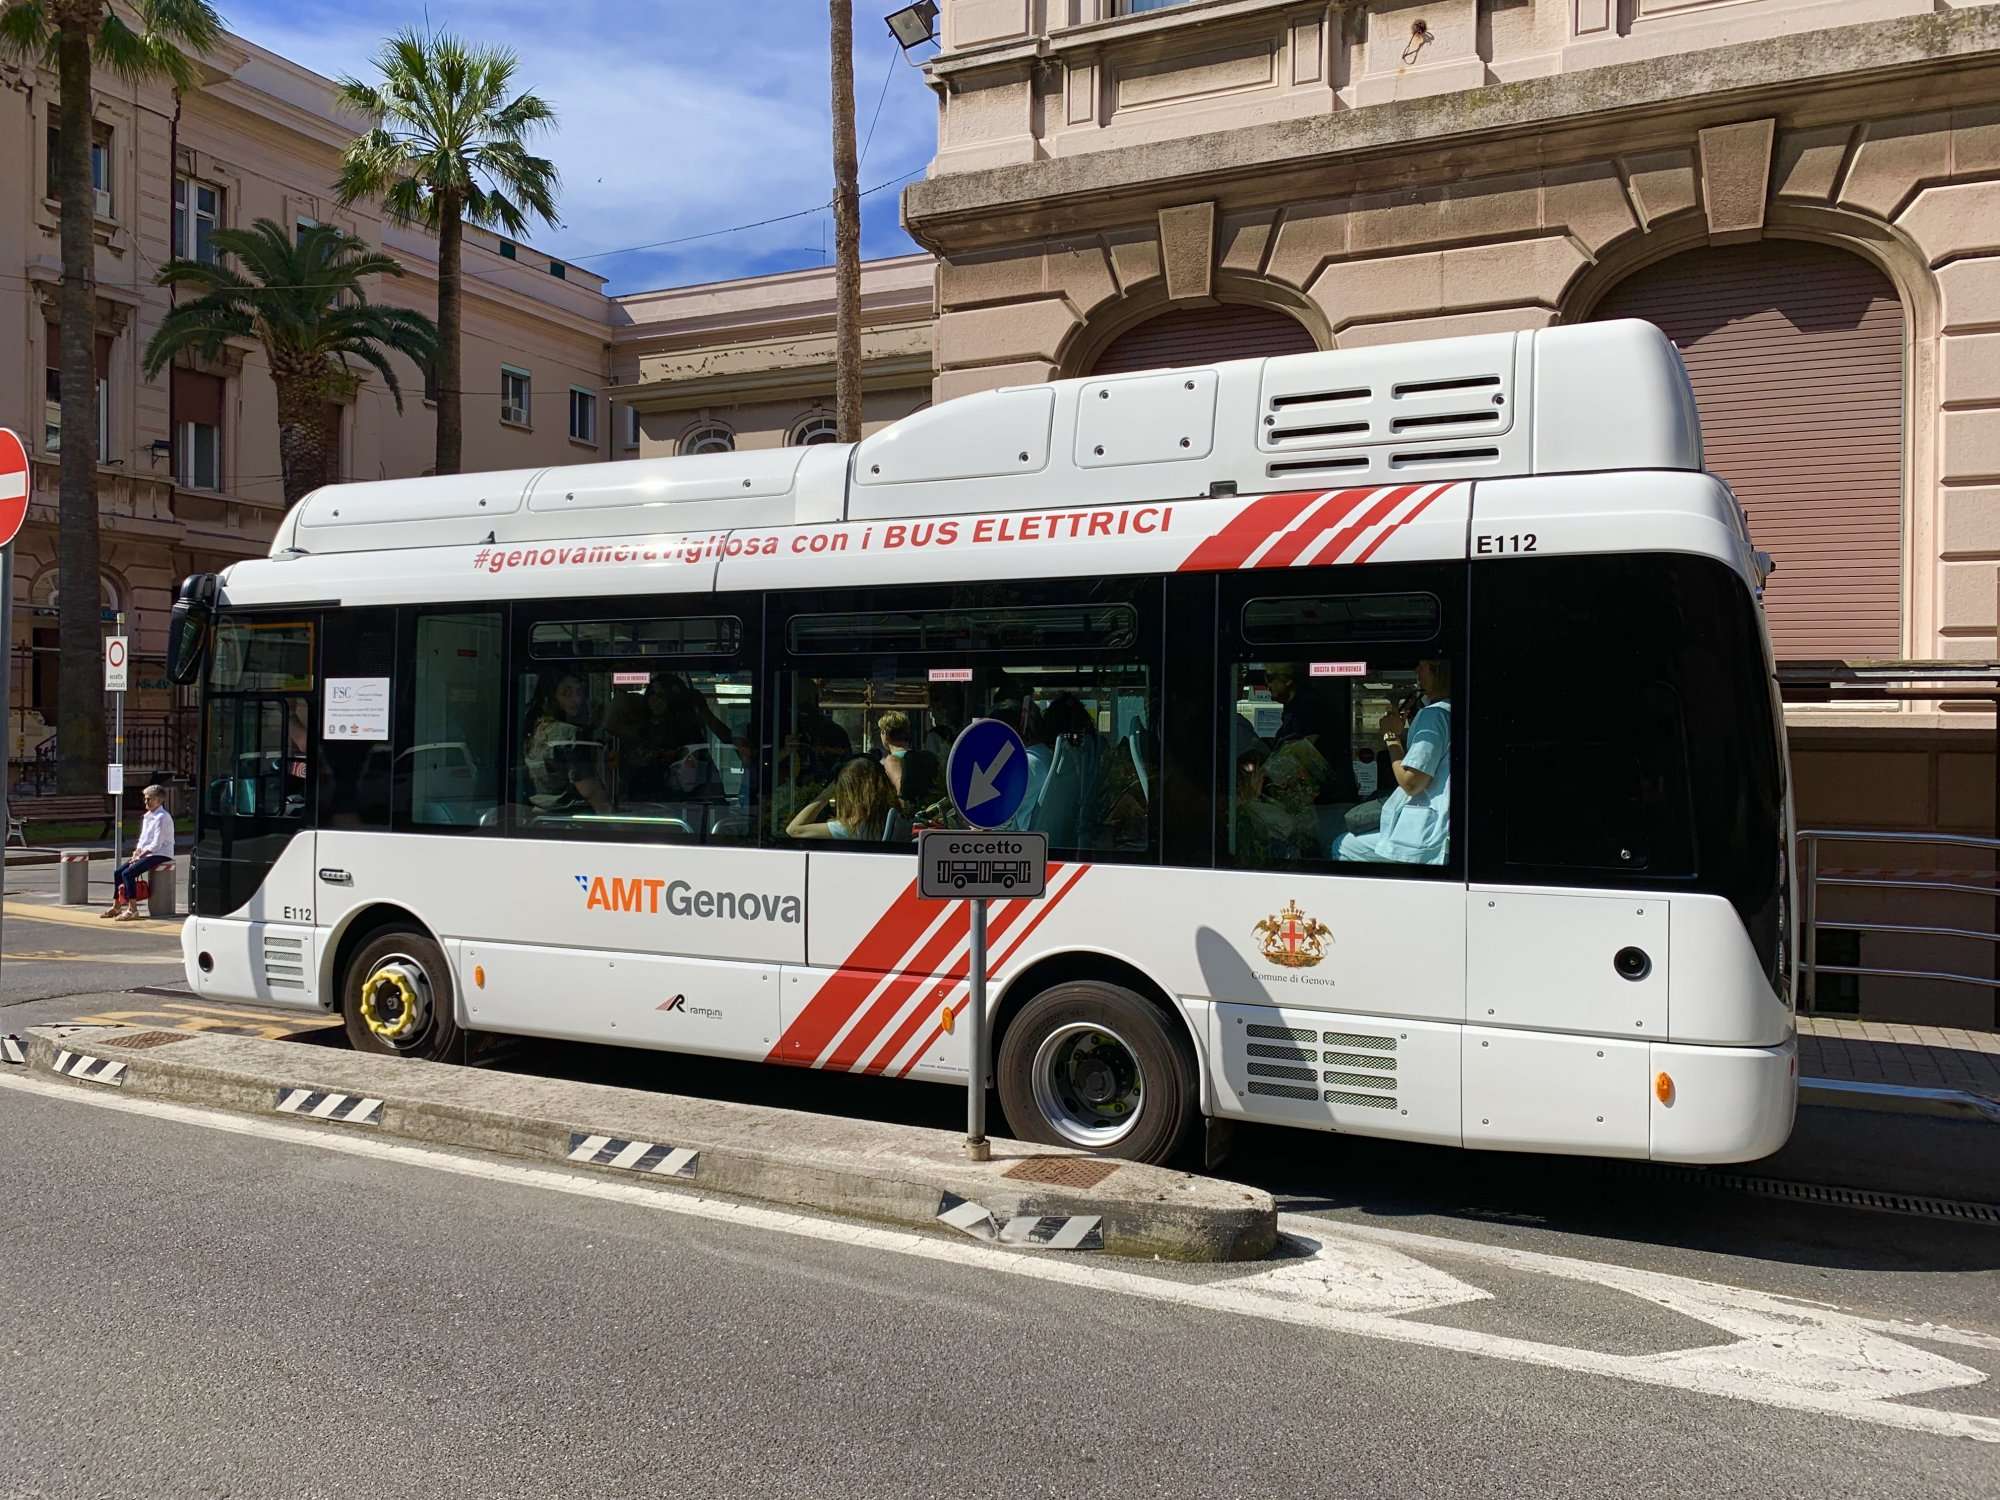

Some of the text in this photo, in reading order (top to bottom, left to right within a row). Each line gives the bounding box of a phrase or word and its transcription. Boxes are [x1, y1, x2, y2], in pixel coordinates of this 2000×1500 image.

[791, 533, 848, 553] con
[861, 527, 871, 550] i
[883, 521, 959, 549] BUS
[972, 507, 1174, 543] ELETTRICI
[1477, 533, 1537, 554] E112
[950, 840, 1022, 854] eccetto
[284, 906, 312, 921] E112
[1251, 970, 1336, 987] Comune di Genova
[690, 1007, 723, 1019] rampini
